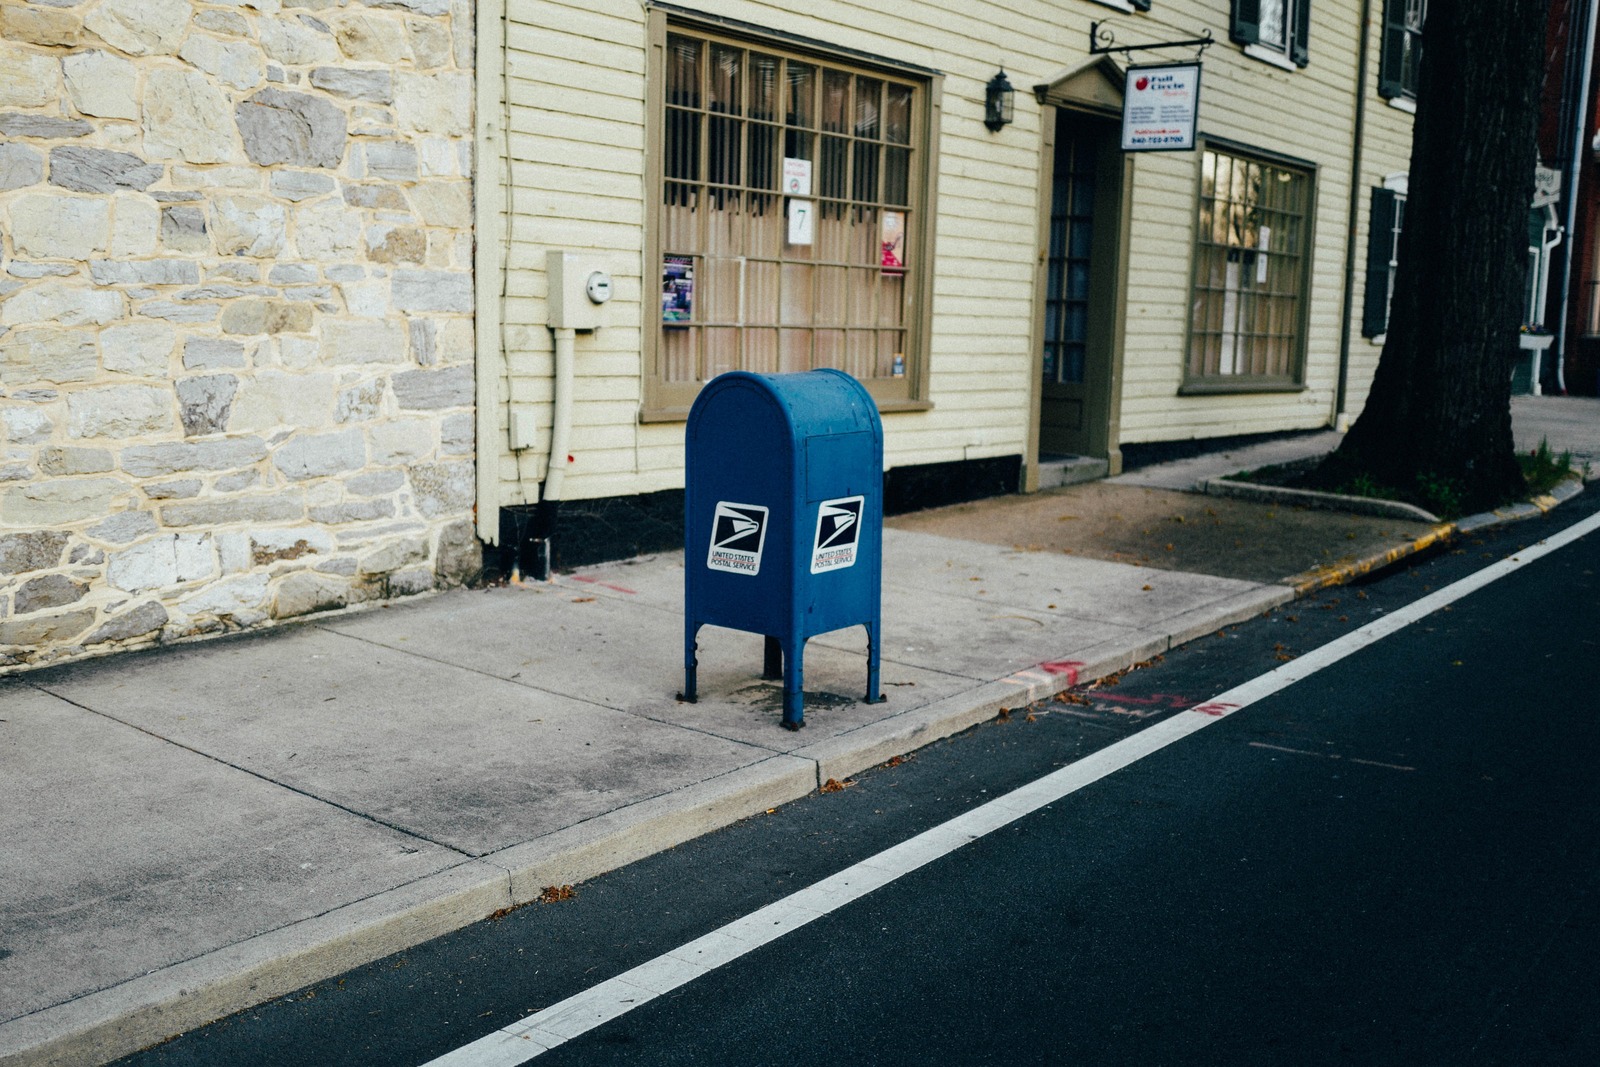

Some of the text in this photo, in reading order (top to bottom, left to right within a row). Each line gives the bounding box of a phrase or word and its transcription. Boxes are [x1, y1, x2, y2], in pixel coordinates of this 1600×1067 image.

[798, 209, 806, 230] 7
[712, 551, 754, 562] UNITED STATES
[816, 548, 852, 559] UNITED STATES
[711, 559, 756, 571] POSTAL SERVICE
[815, 556, 853, 568] POSTAL SERVICE
